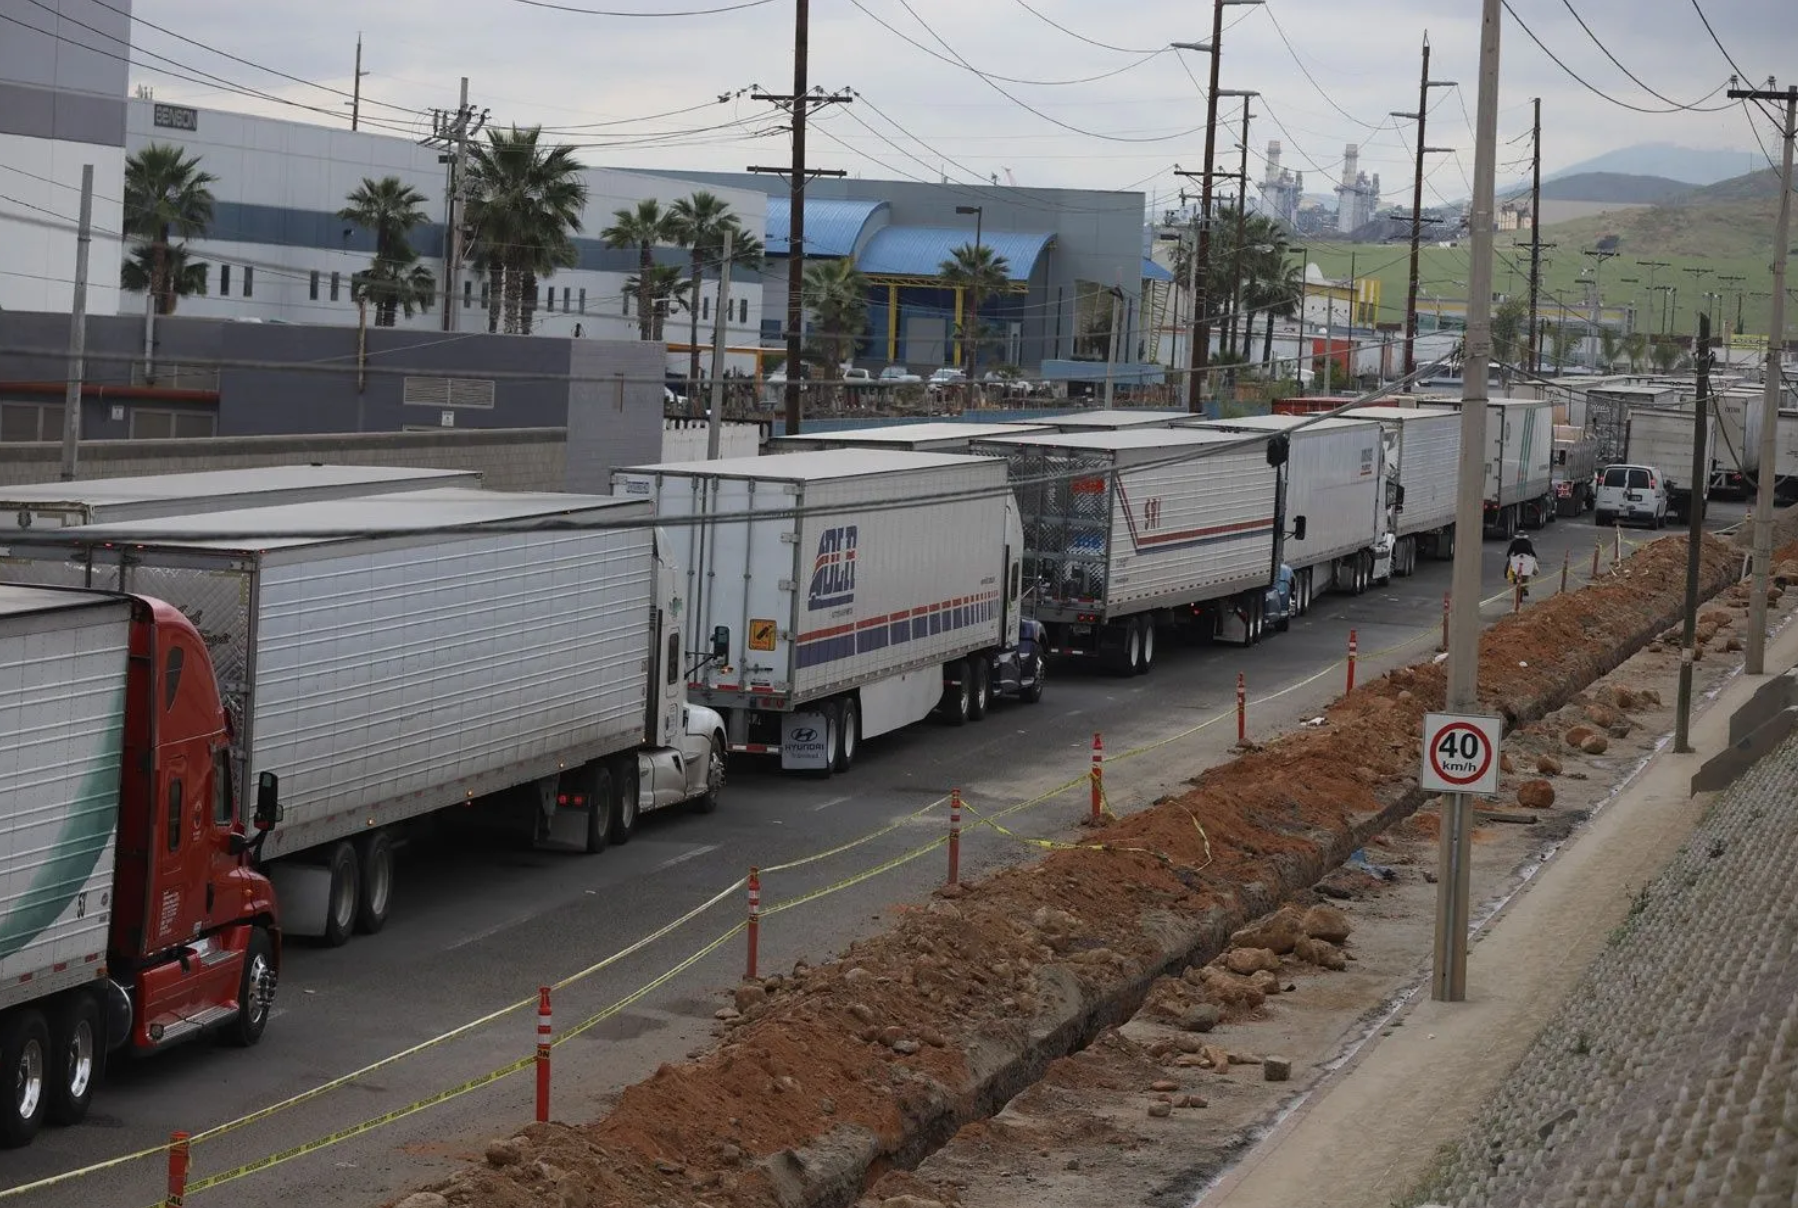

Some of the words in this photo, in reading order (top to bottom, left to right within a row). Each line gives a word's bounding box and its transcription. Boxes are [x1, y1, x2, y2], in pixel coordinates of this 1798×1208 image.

[156, 105, 197, 129] BENSON
[785, 743, 824, 751] HYUNDAI
[1439, 732, 1478, 759] 40
[1442, 761, 1476, 772] km/h
